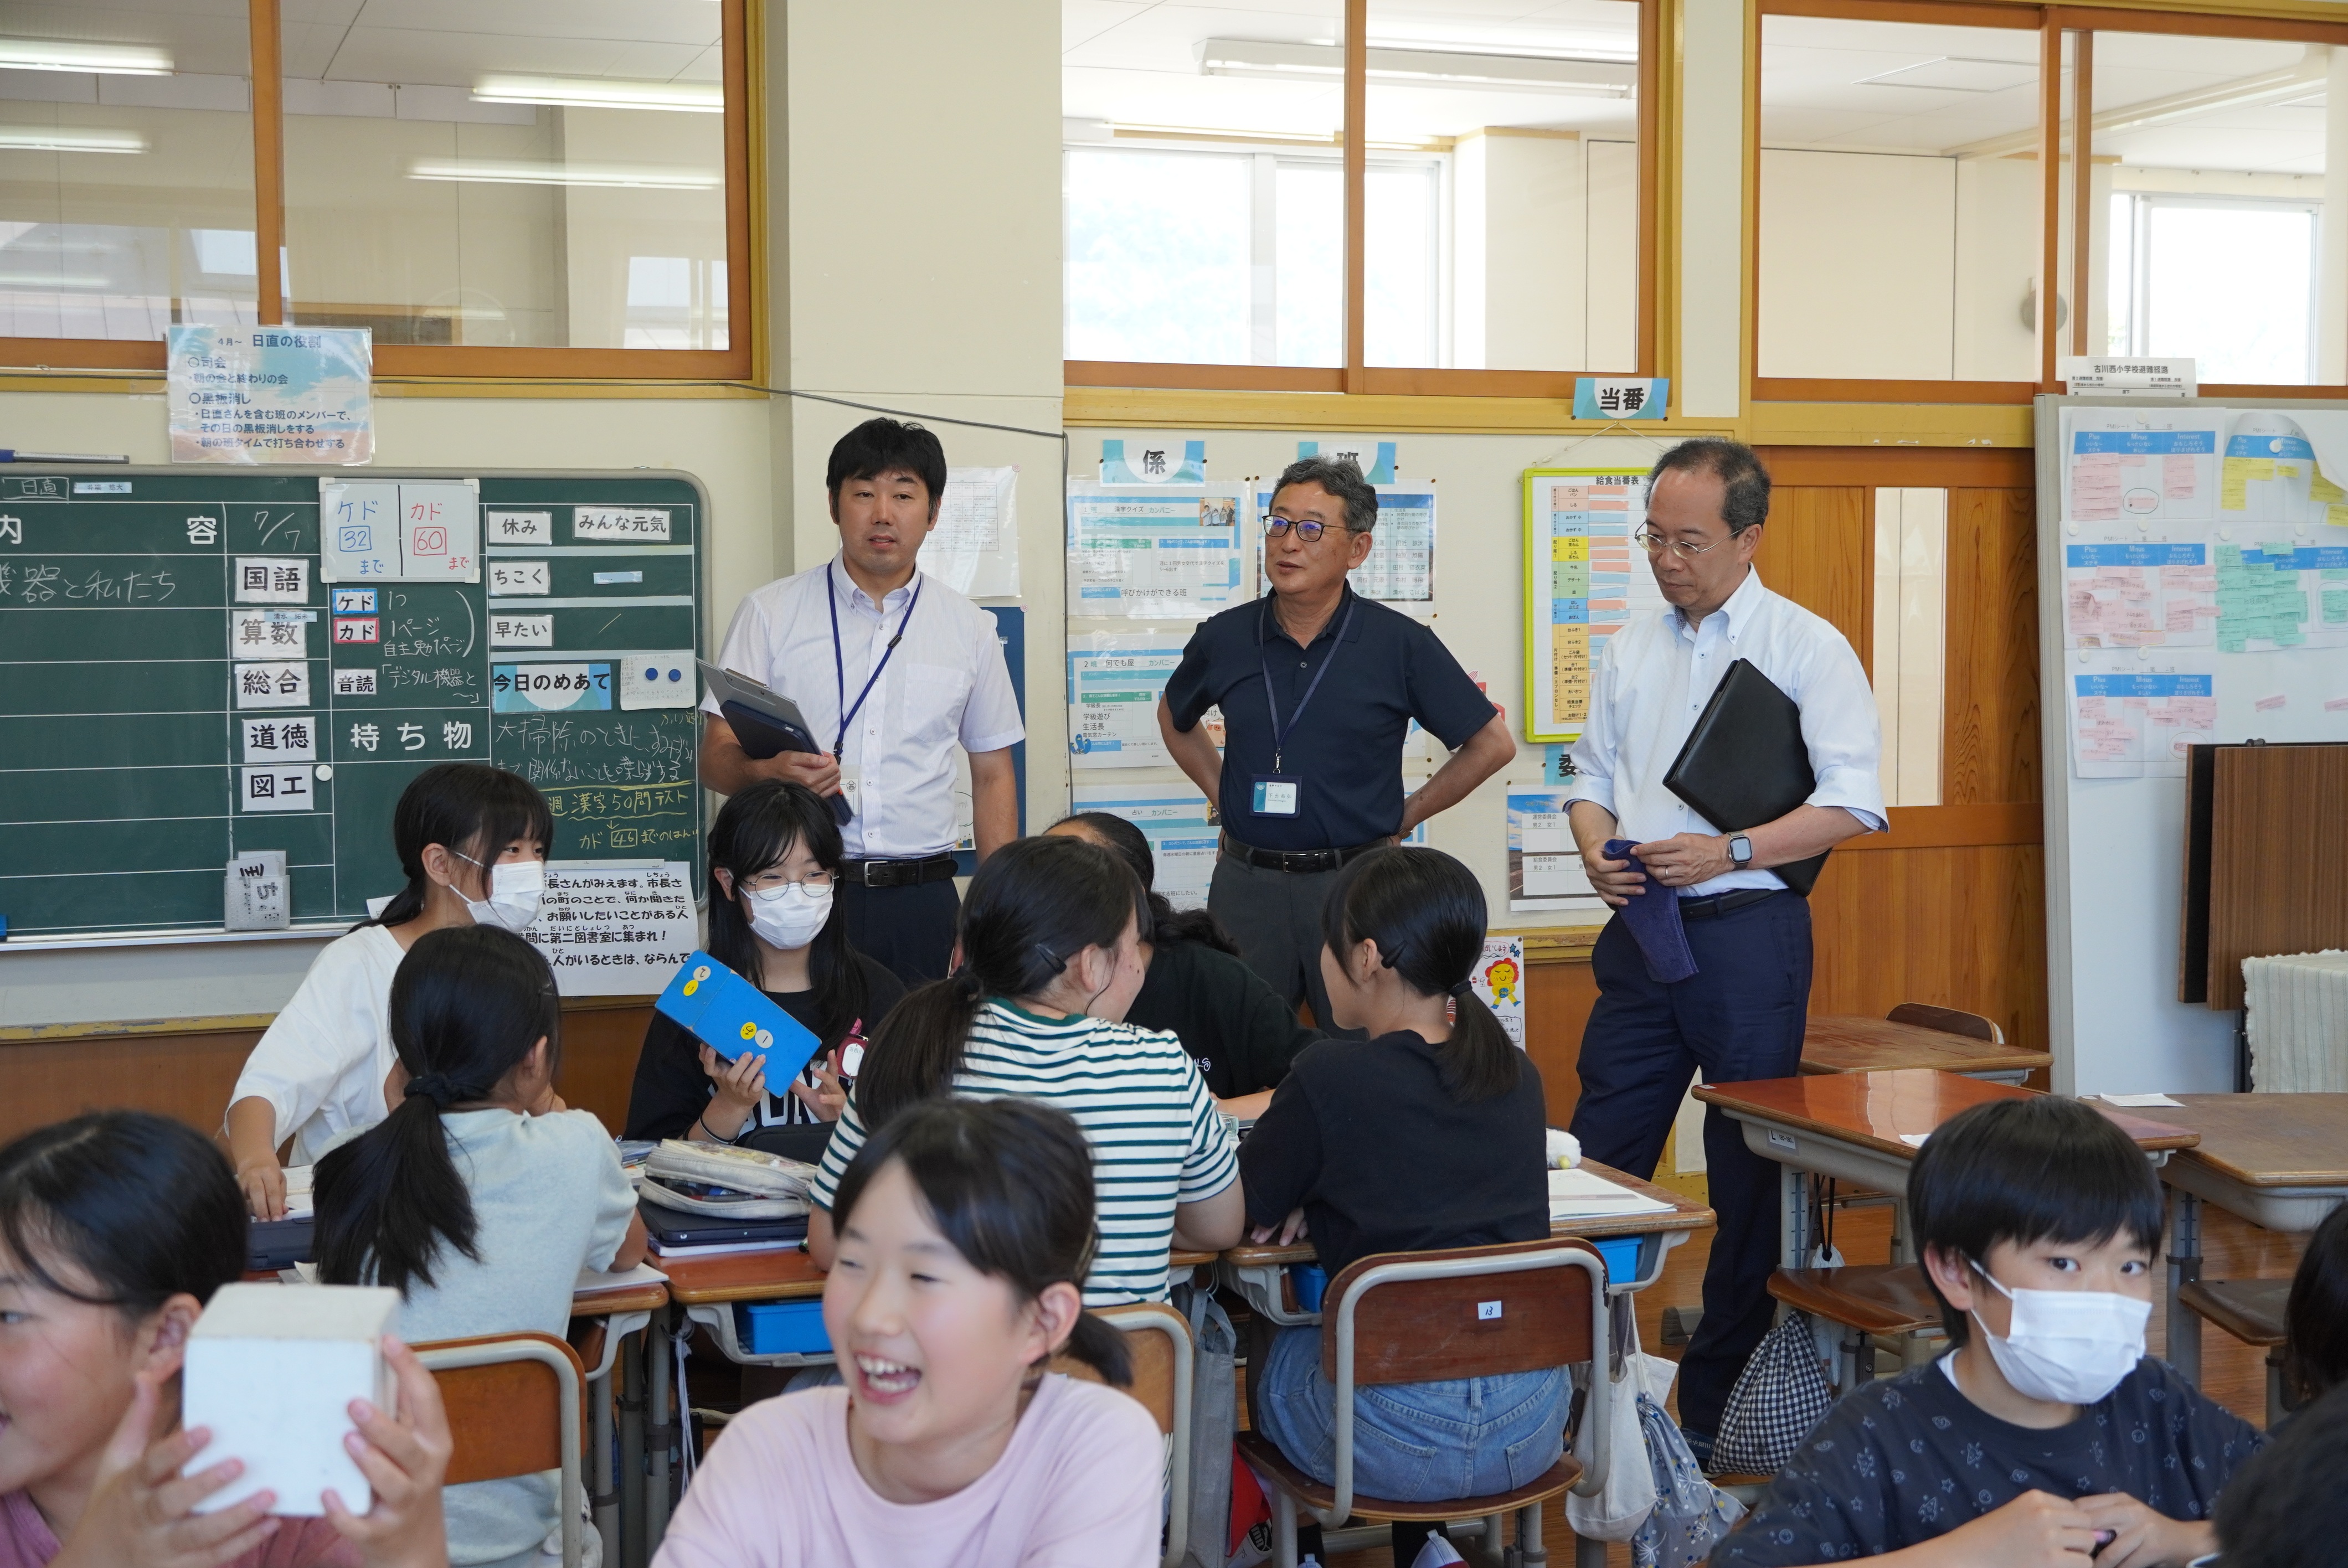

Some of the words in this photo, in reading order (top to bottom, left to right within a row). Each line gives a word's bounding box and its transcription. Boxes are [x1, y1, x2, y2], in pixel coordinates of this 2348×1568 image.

[253, 334, 321, 348] 日直の役割
[2094, 365, 2168, 374] 古川西小学校避難経路
[1600, 388, 1644, 411] 当番
[200, 424, 314, 434] その日の黒板消しをする
[1142, 450, 1166, 475] 係
[22, 478, 57, 495] 日直
[1596, 476, 1639, 485] 給食当番表
[338, 501, 378, 522] ケド
[410, 503, 443, 522] カド
[186, 516, 217, 545] 容
[502, 518, 537, 535] 休み
[578, 515, 666, 534] みんな元気
[343, 530, 368, 549] 32
[416, 530, 443, 549] 60
[360, 559, 384, 575] まで
[449, 556, 469, 570] まで
[243, 566, 301, 592] 国語
[494, 568, 543, 585] ちこく
[338, 594, 375, 611] ケド
[240, 618, 298, 646] 算数
[338, 625, 376, 641] カド
[495, 622, 548, 637] 早たい
[1106, 659, 1134, 667] 何でも屋
[243, 669, 302, 695] 総合
[337, 674, 374, 694] 音読
[493, 672, 610, 692] 今日のめあて
[250, 723, 309, 750] 道徳
[351, 721, 472, 752] 持ち物
[251, 774, 306, 798] 図工
[579, 832, 603, 850] カド
[1485, 1306, 1493, 1316] 13
